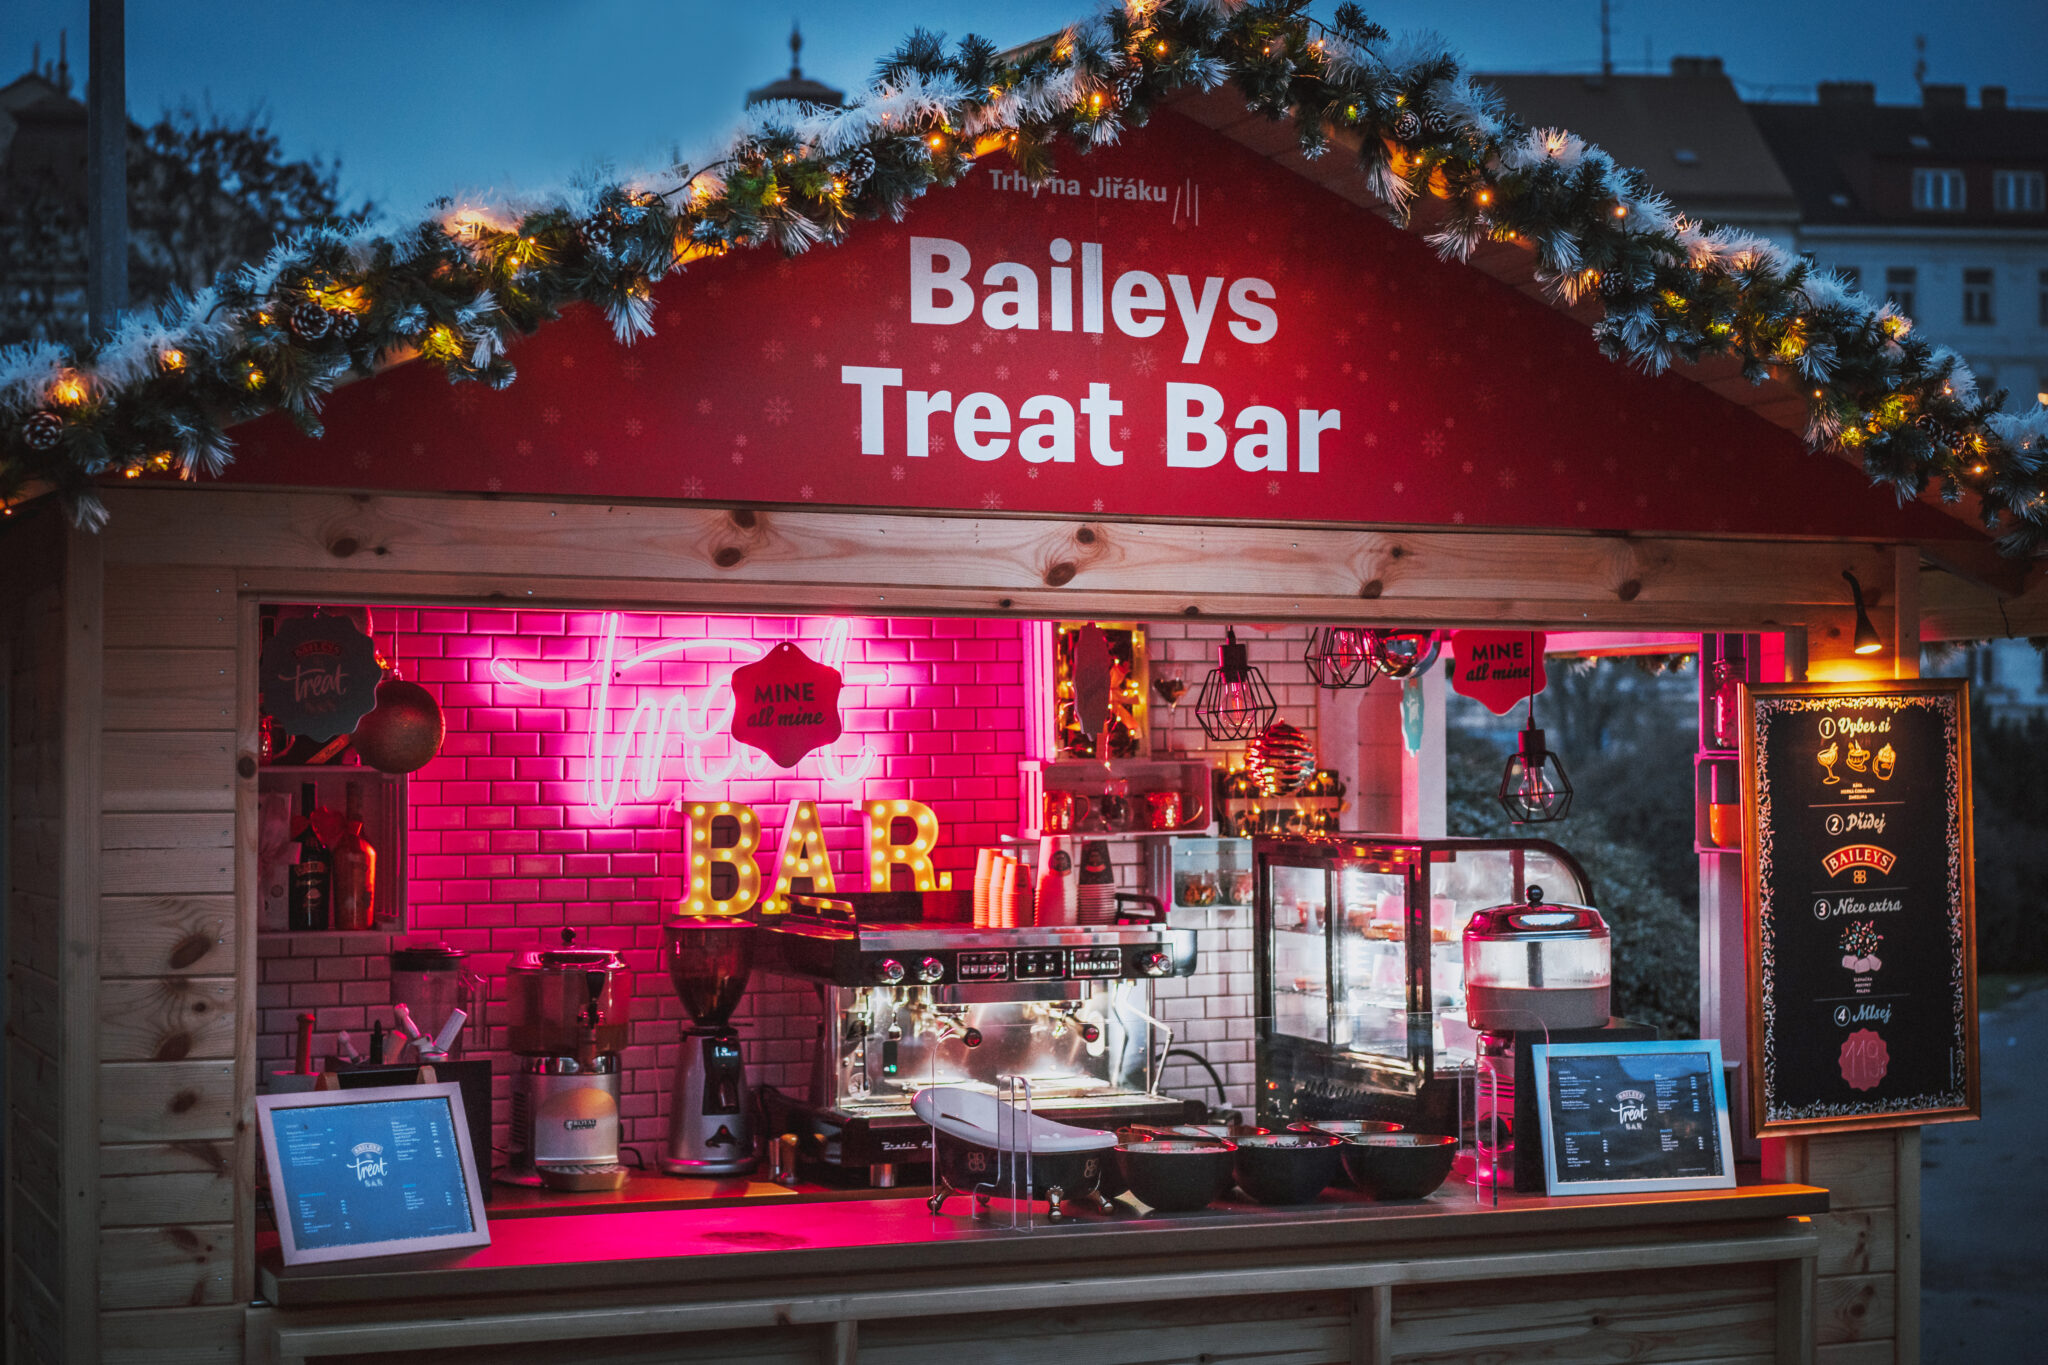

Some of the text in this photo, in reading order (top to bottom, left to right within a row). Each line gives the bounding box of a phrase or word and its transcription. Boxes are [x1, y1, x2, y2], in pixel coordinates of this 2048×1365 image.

[1051, 177, 1081, 196] na
[1089, 176, 1167, 202] Jiřáku
[909, 236, 1279, 365] Baileys
[841, 365, 1341, 473] Treat Bar
[1472, 642, 1524, 661] MINE
[1466, 663, 1530, 681] all mine
[754, 682, 816, 704] MINE
[747, 705, 826, 728] all mine
[1837, 716, 1878, 738] Vyber
[1878, 716, 1892, 733] si
[1845, 811, 1887, 834] Přidej
[672, 799, 953, 917] BAR
[1828, 848, 1890, 870] BAILEYS
[1832, 897, 1867, 917] Něco
[1868, 898, 1902, 913] extra
[1852, 1003, 1892, 1024] Mlsej
[1610, 1103, 1648, 1124] treat
